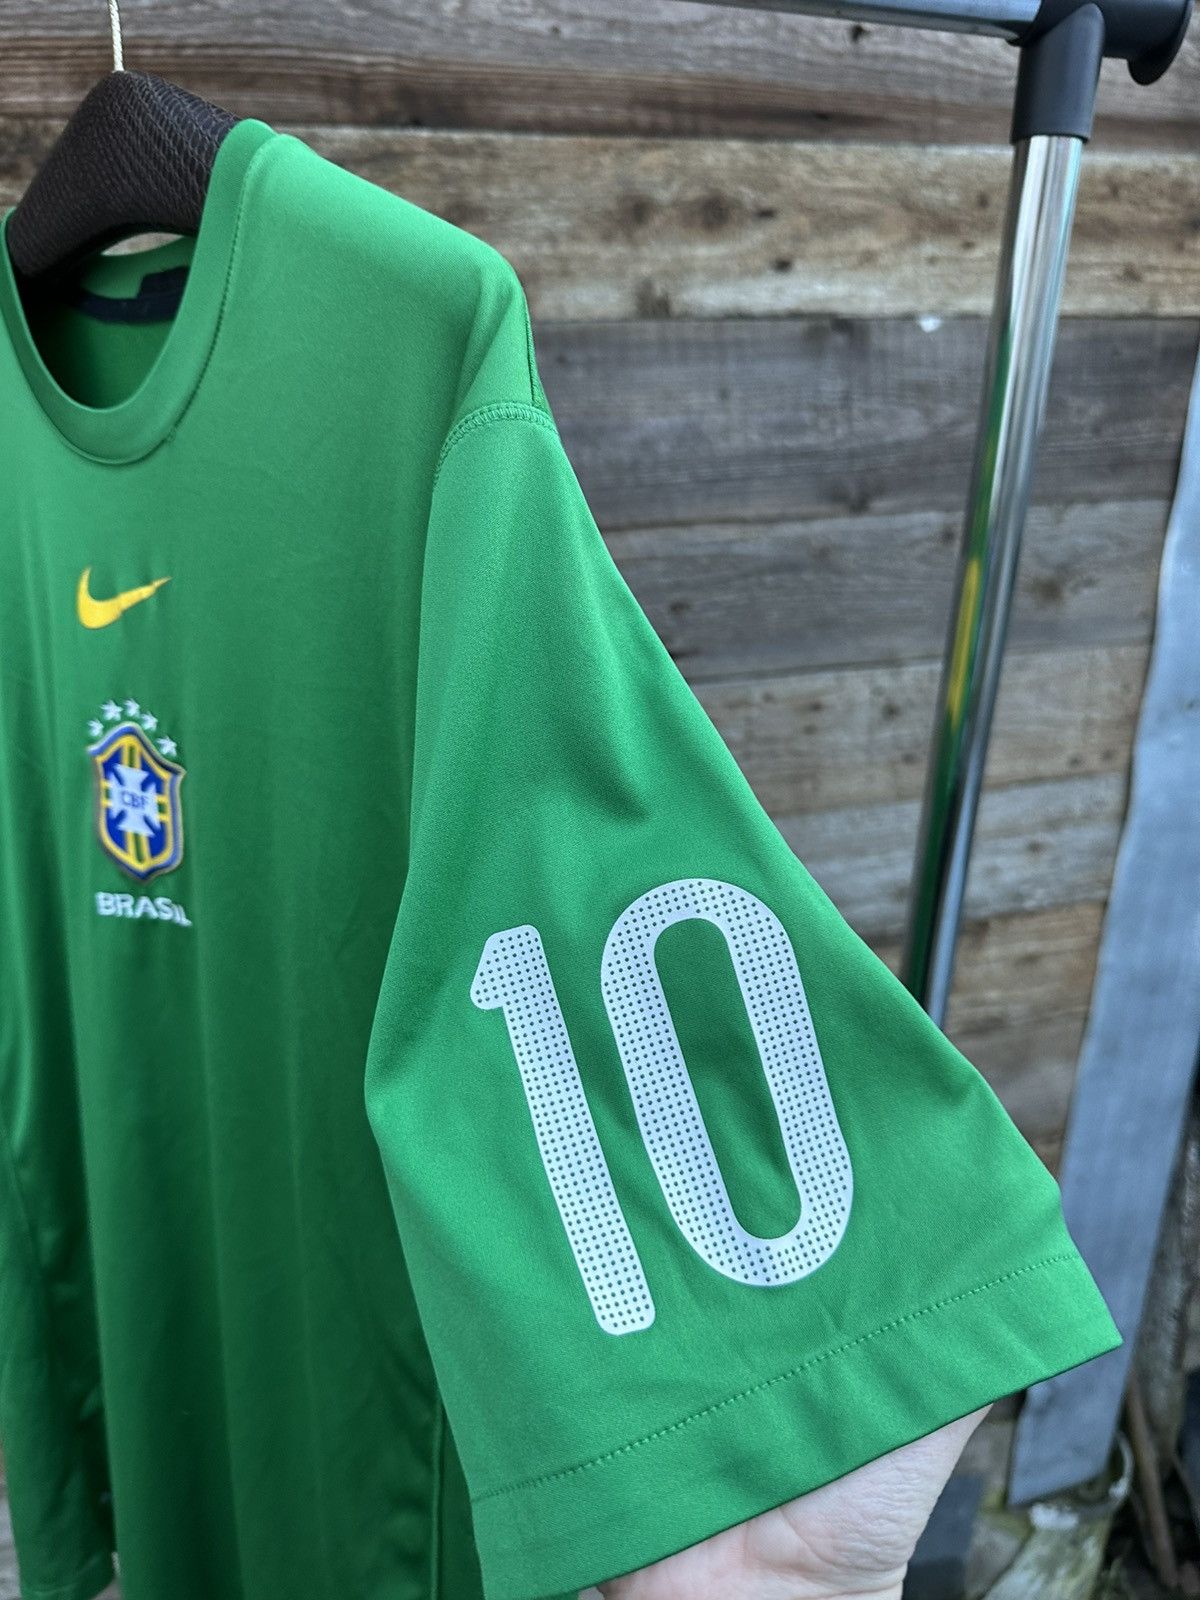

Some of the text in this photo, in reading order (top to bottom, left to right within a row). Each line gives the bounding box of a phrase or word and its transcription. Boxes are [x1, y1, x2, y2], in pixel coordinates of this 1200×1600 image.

[121, 790, 149, 809] CBF
[95, 891, 192, 927] BRASIL
[470, 878, 854, 1335] 10
